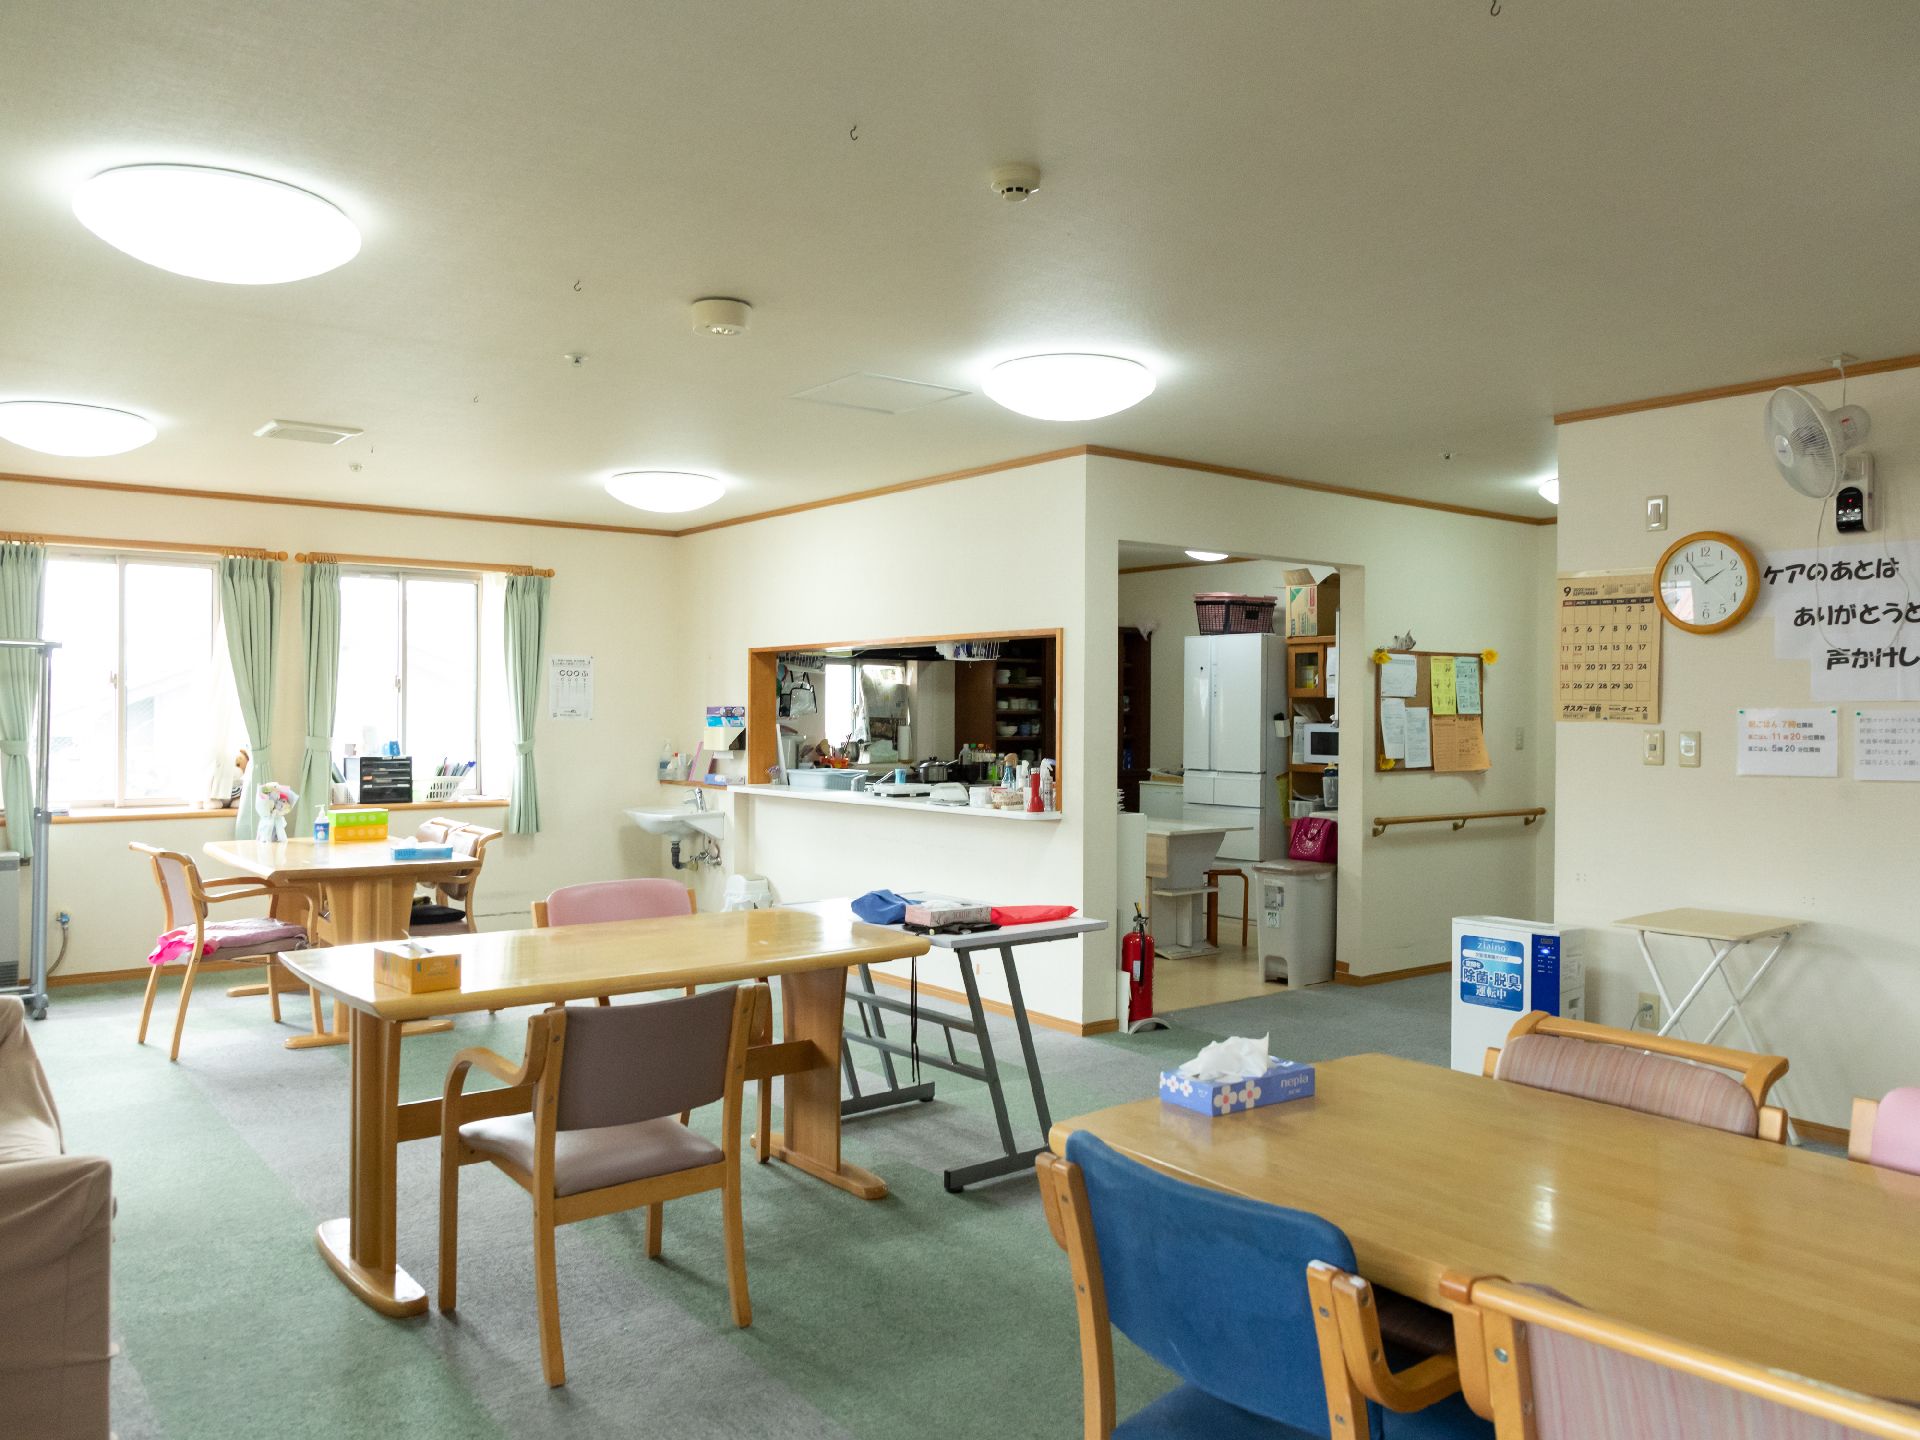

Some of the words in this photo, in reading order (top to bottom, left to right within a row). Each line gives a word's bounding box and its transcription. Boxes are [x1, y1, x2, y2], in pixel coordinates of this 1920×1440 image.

[1701, 547, 1710, 557] 12
[1720, 550, 1723, 560] 1
[1674, 564, 1683, 575] 10
[1730, 560, 1738, 570] 2
[1763, 557, 1899, 585] ケアのあとは
[1735, 576, 1743, 587] 3
[1563, 586, 1571, 597] 9
[1702, 608, 1710, 619] 6
[1719, 604, 1727, 614] 5
[1793, 602, 1920, 626] ありがとうと
[1826, 647, 1920, 670] 声かけし
[1748, 720, 1777, 728] ごはん
[1463, 967, 1521, 991] 除菌・脱臭
[1476, 985, 1507, 1000] 運転中
[1280, 1073, 1309, 1089] nepia
